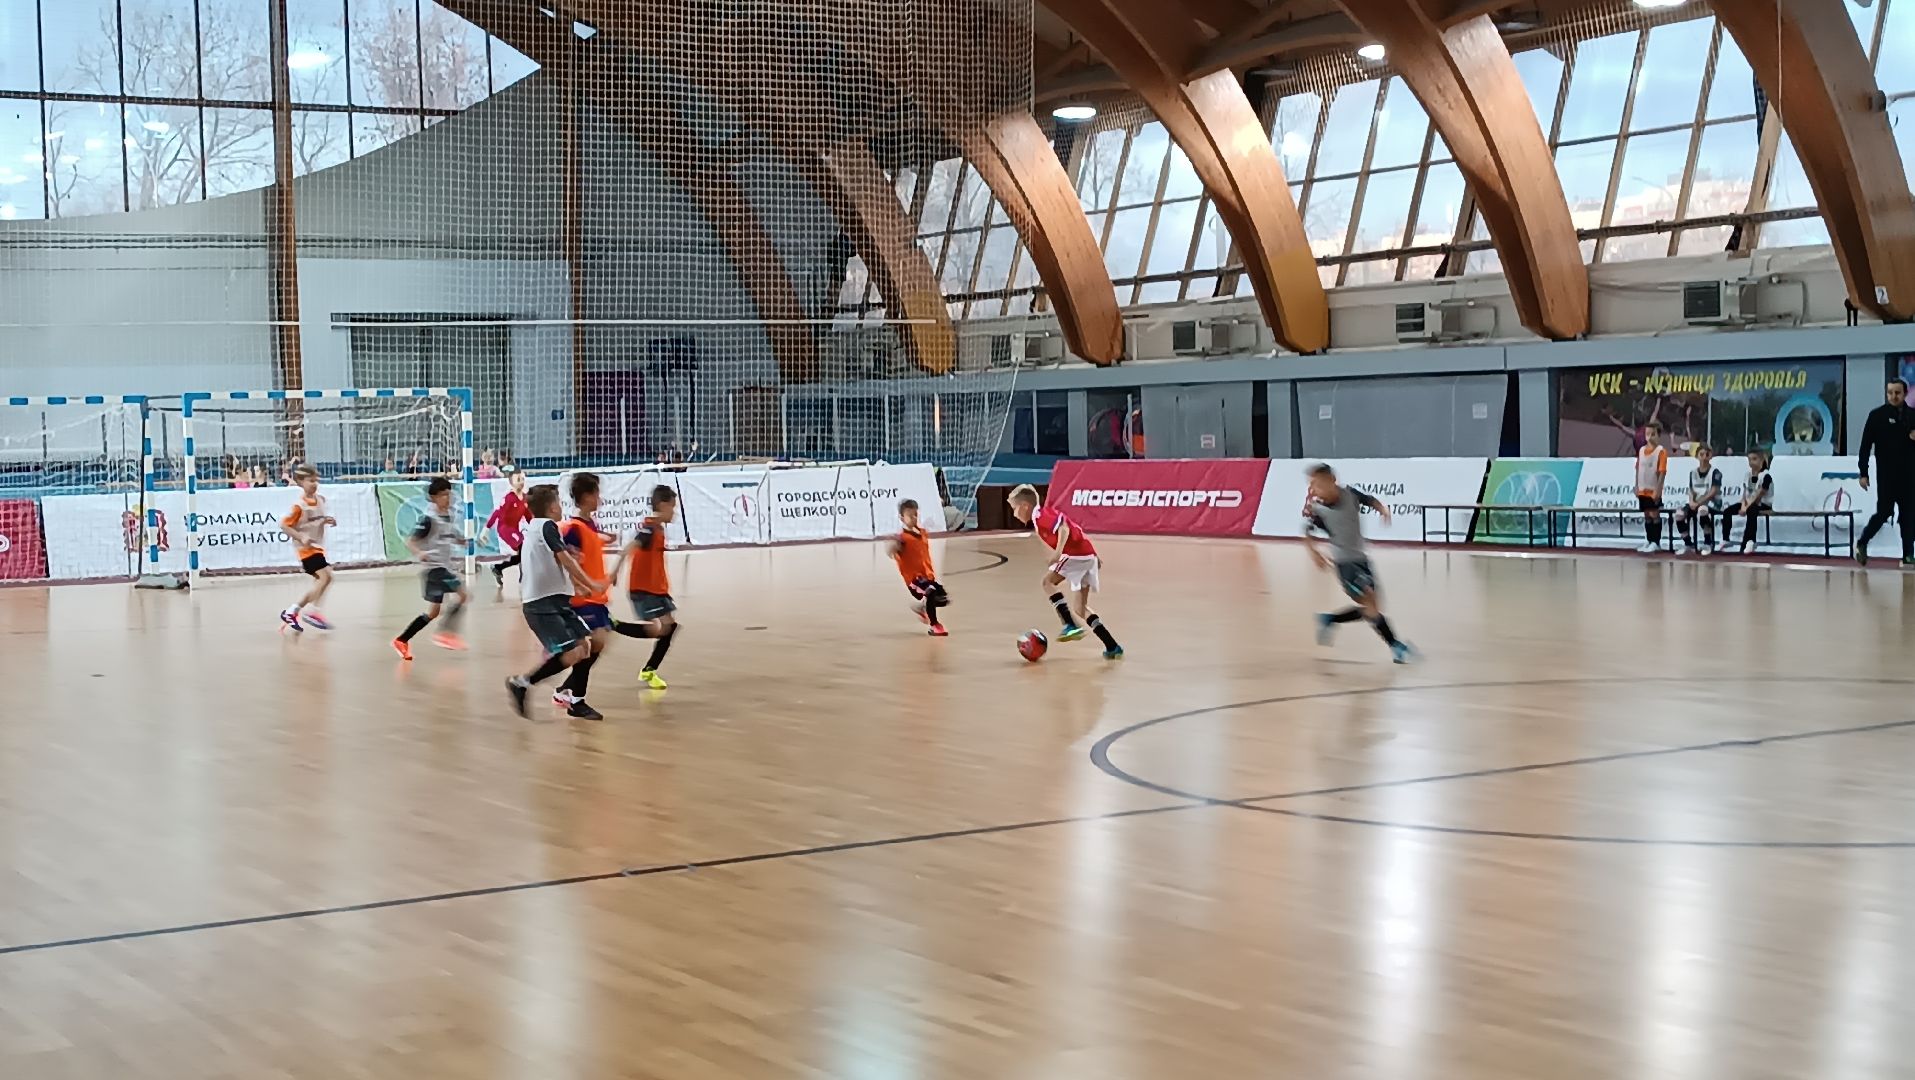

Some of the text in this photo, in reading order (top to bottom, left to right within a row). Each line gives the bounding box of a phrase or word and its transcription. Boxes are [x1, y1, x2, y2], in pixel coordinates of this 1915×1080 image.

[1589, 372, 1623, 397] УСК
[1644, 373, 1715, 395] КУЗНИЦА
[1723, 370, 1807, 393] ЗДОРОВЬЯ
[777, 487, 857, 502] ГОРОДСКОЙ
[1354, 483, 1405, 496] МАНДА
[1072, 490, 1221, 507] МОСОБЛСПОРТ
[780, 505, 847, 518] ЩЕЛКОВО
[187, 531, 291, 547] УБЕРНАТО
